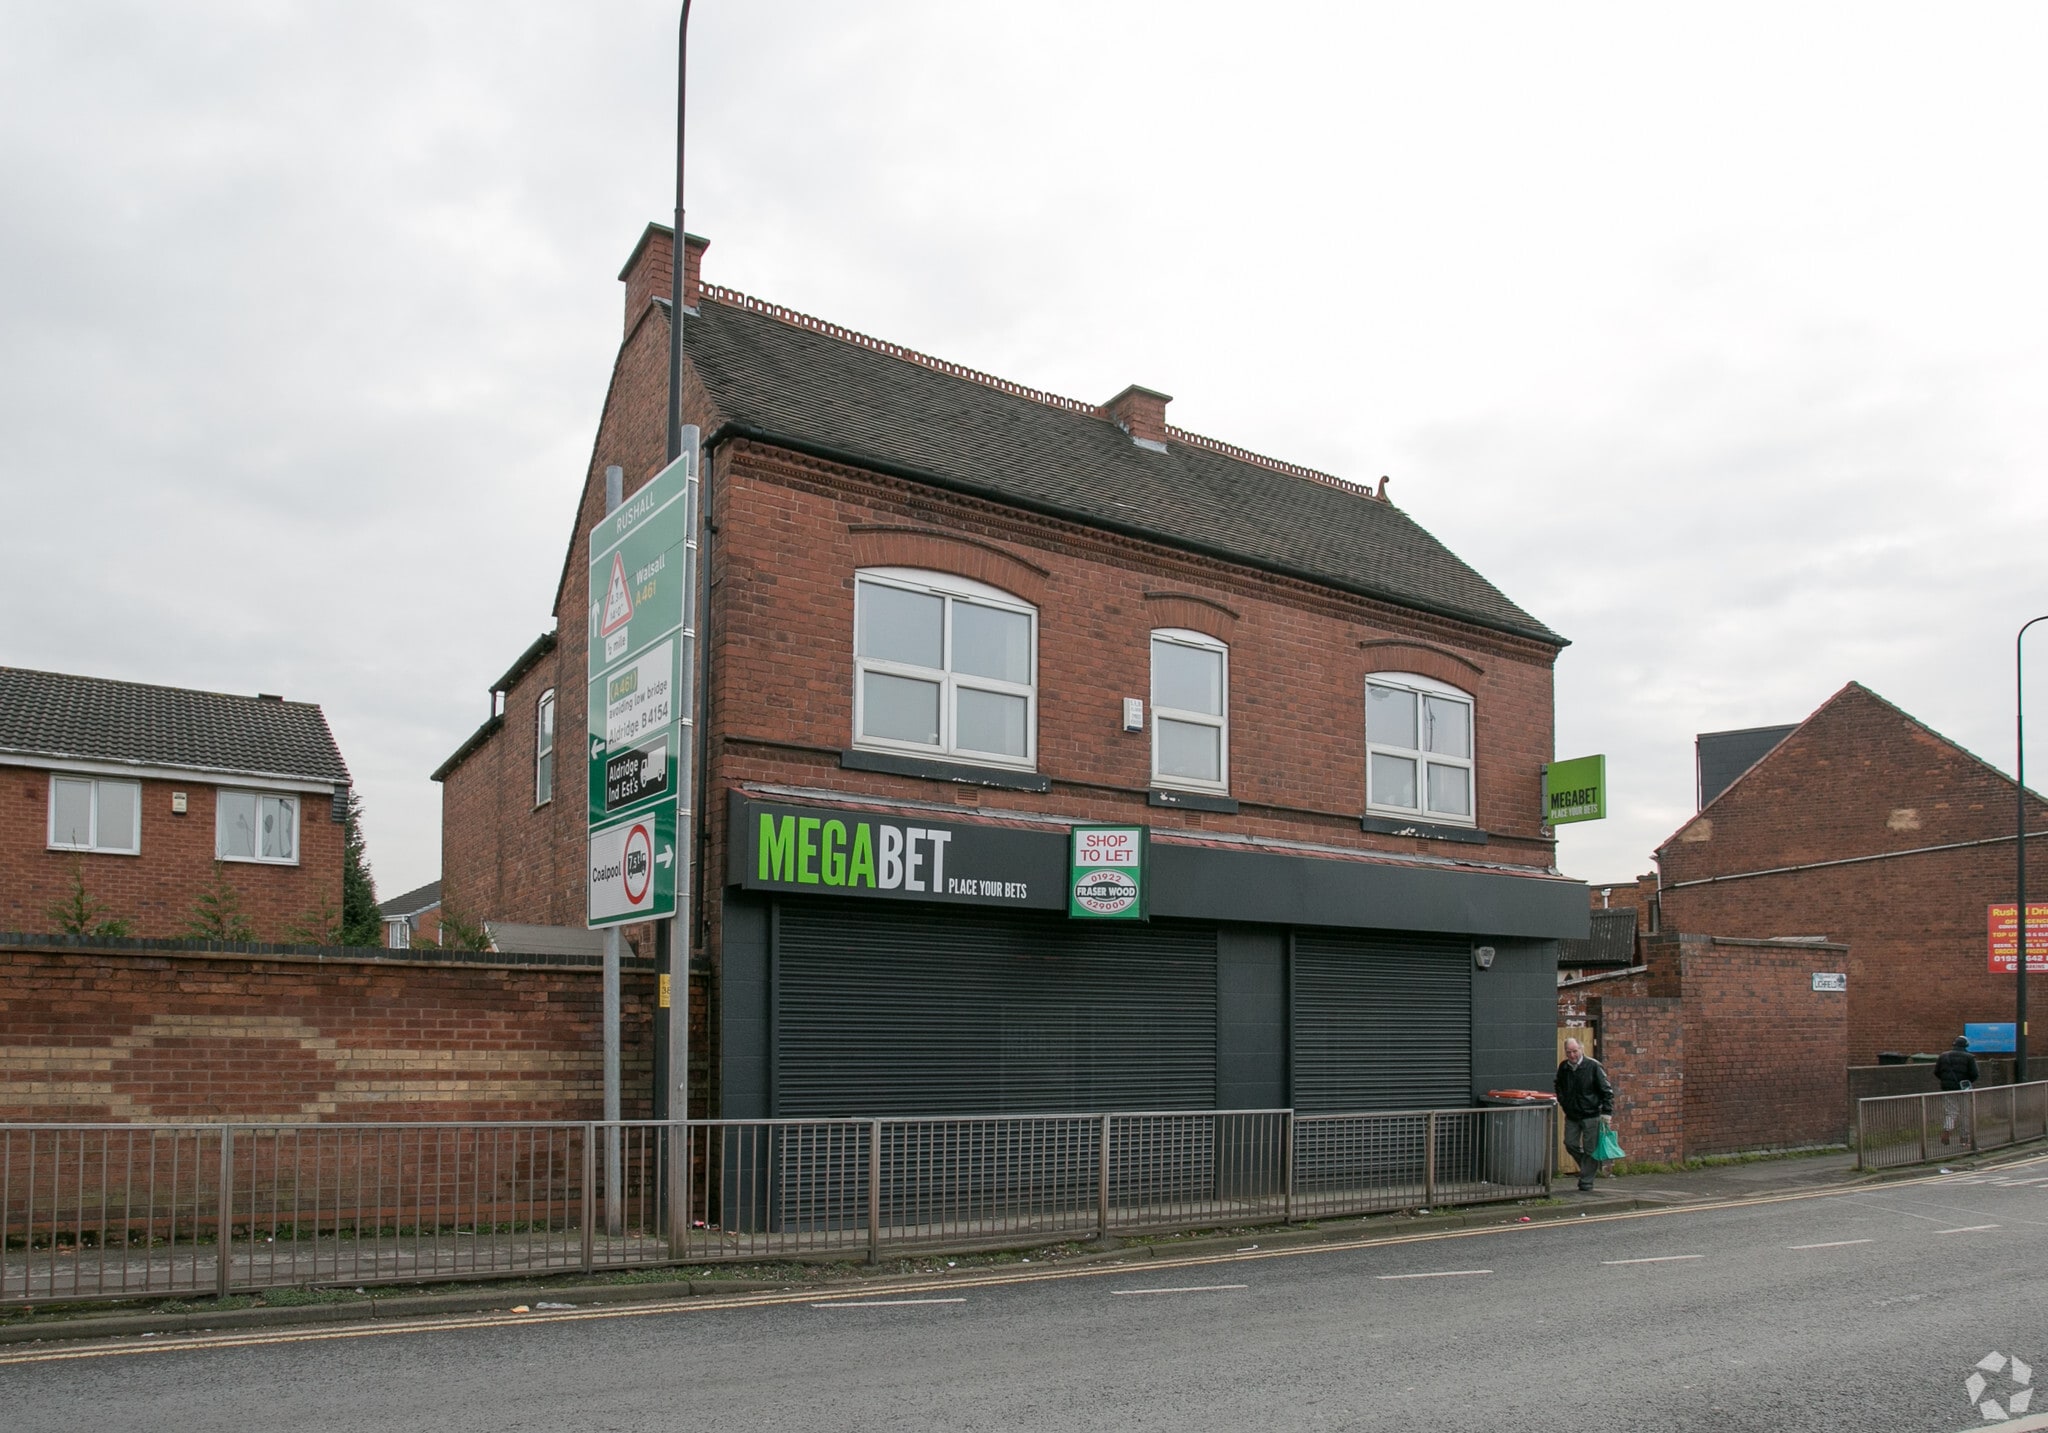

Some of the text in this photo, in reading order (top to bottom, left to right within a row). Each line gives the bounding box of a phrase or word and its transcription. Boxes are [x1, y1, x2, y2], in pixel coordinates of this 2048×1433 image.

[616, 492, 655, 534] RUSHALL
[636, 553, 665, 585] Walsall
[609, 680, 667, 719] avoiding low bridge
[609, 720, 638, 745] Aldridge
[609, 759, 638, 782] Aldridge
[609, 777, 638, 802] Ind Est's
[1551, 787, 1597, 809] MEGABET
[1551, 804, 1597, 819] PLACE YOUR BETS
[1086, 835, 1127, 847] SHOP
[758, 813, 1027, 899] MEGABET PLACE YOUR BETS
[1080, 850, 1133, 861] TO LET
[593, 861, 621, 882] Coalpool
[1091, 873, 1121, 883] 01922
[1077, 887, 1135, 896] FRASER WOOD
[1087, 900, 1125, 910] 629000
